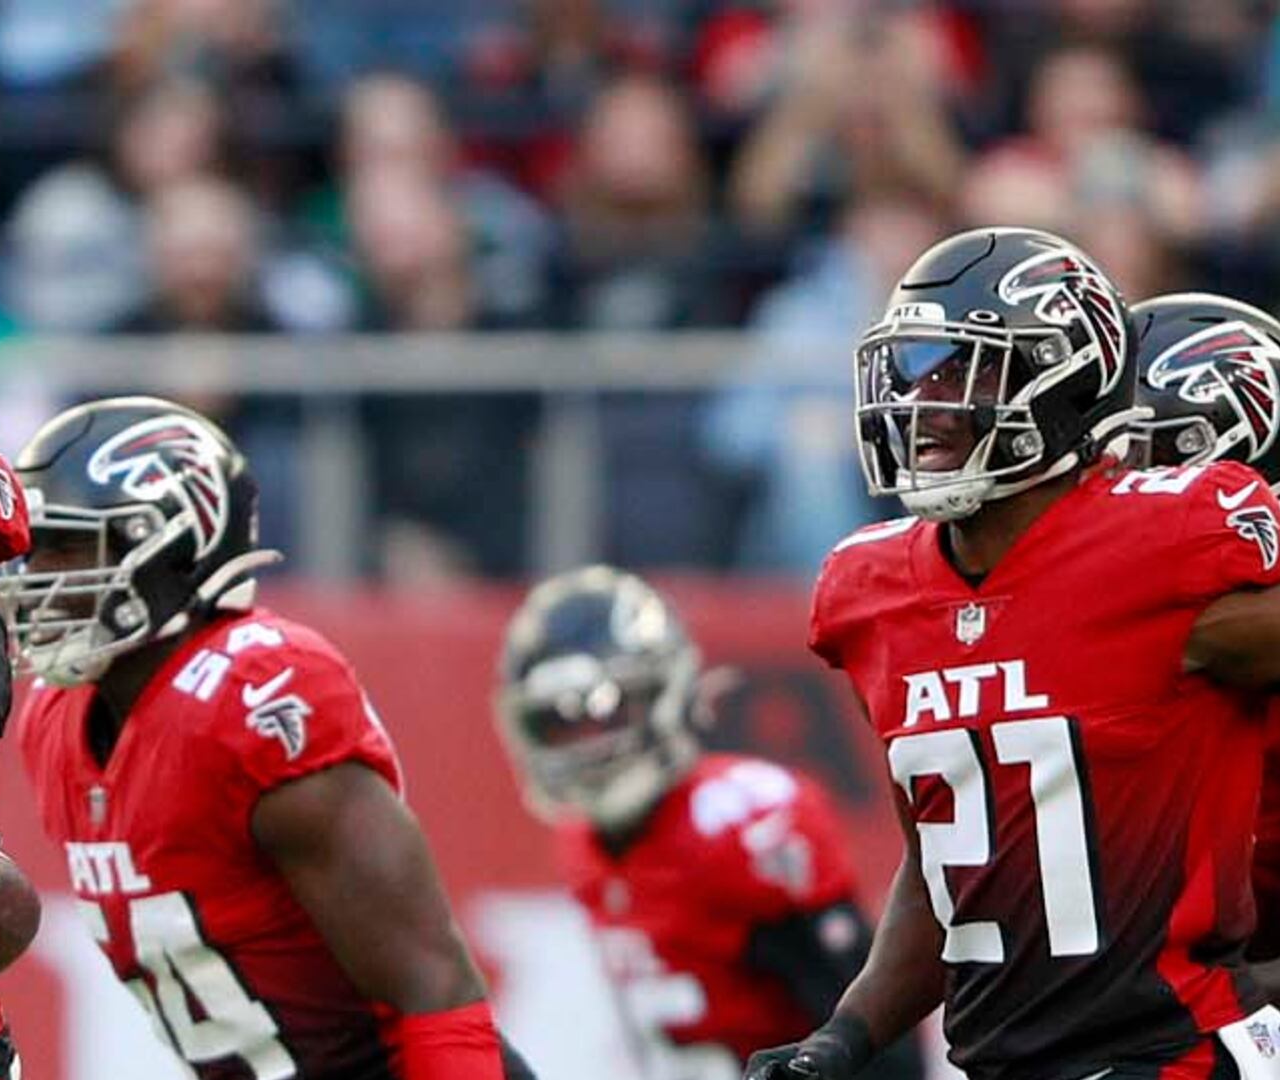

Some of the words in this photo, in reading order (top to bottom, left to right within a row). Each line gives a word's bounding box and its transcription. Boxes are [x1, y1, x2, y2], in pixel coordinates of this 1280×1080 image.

[172, 622, 285, 702] 54
[903, 659, 1049, 727] ATL
[65, 841, 151, 893] ATL
[887, 715, 1100, 964] 21
